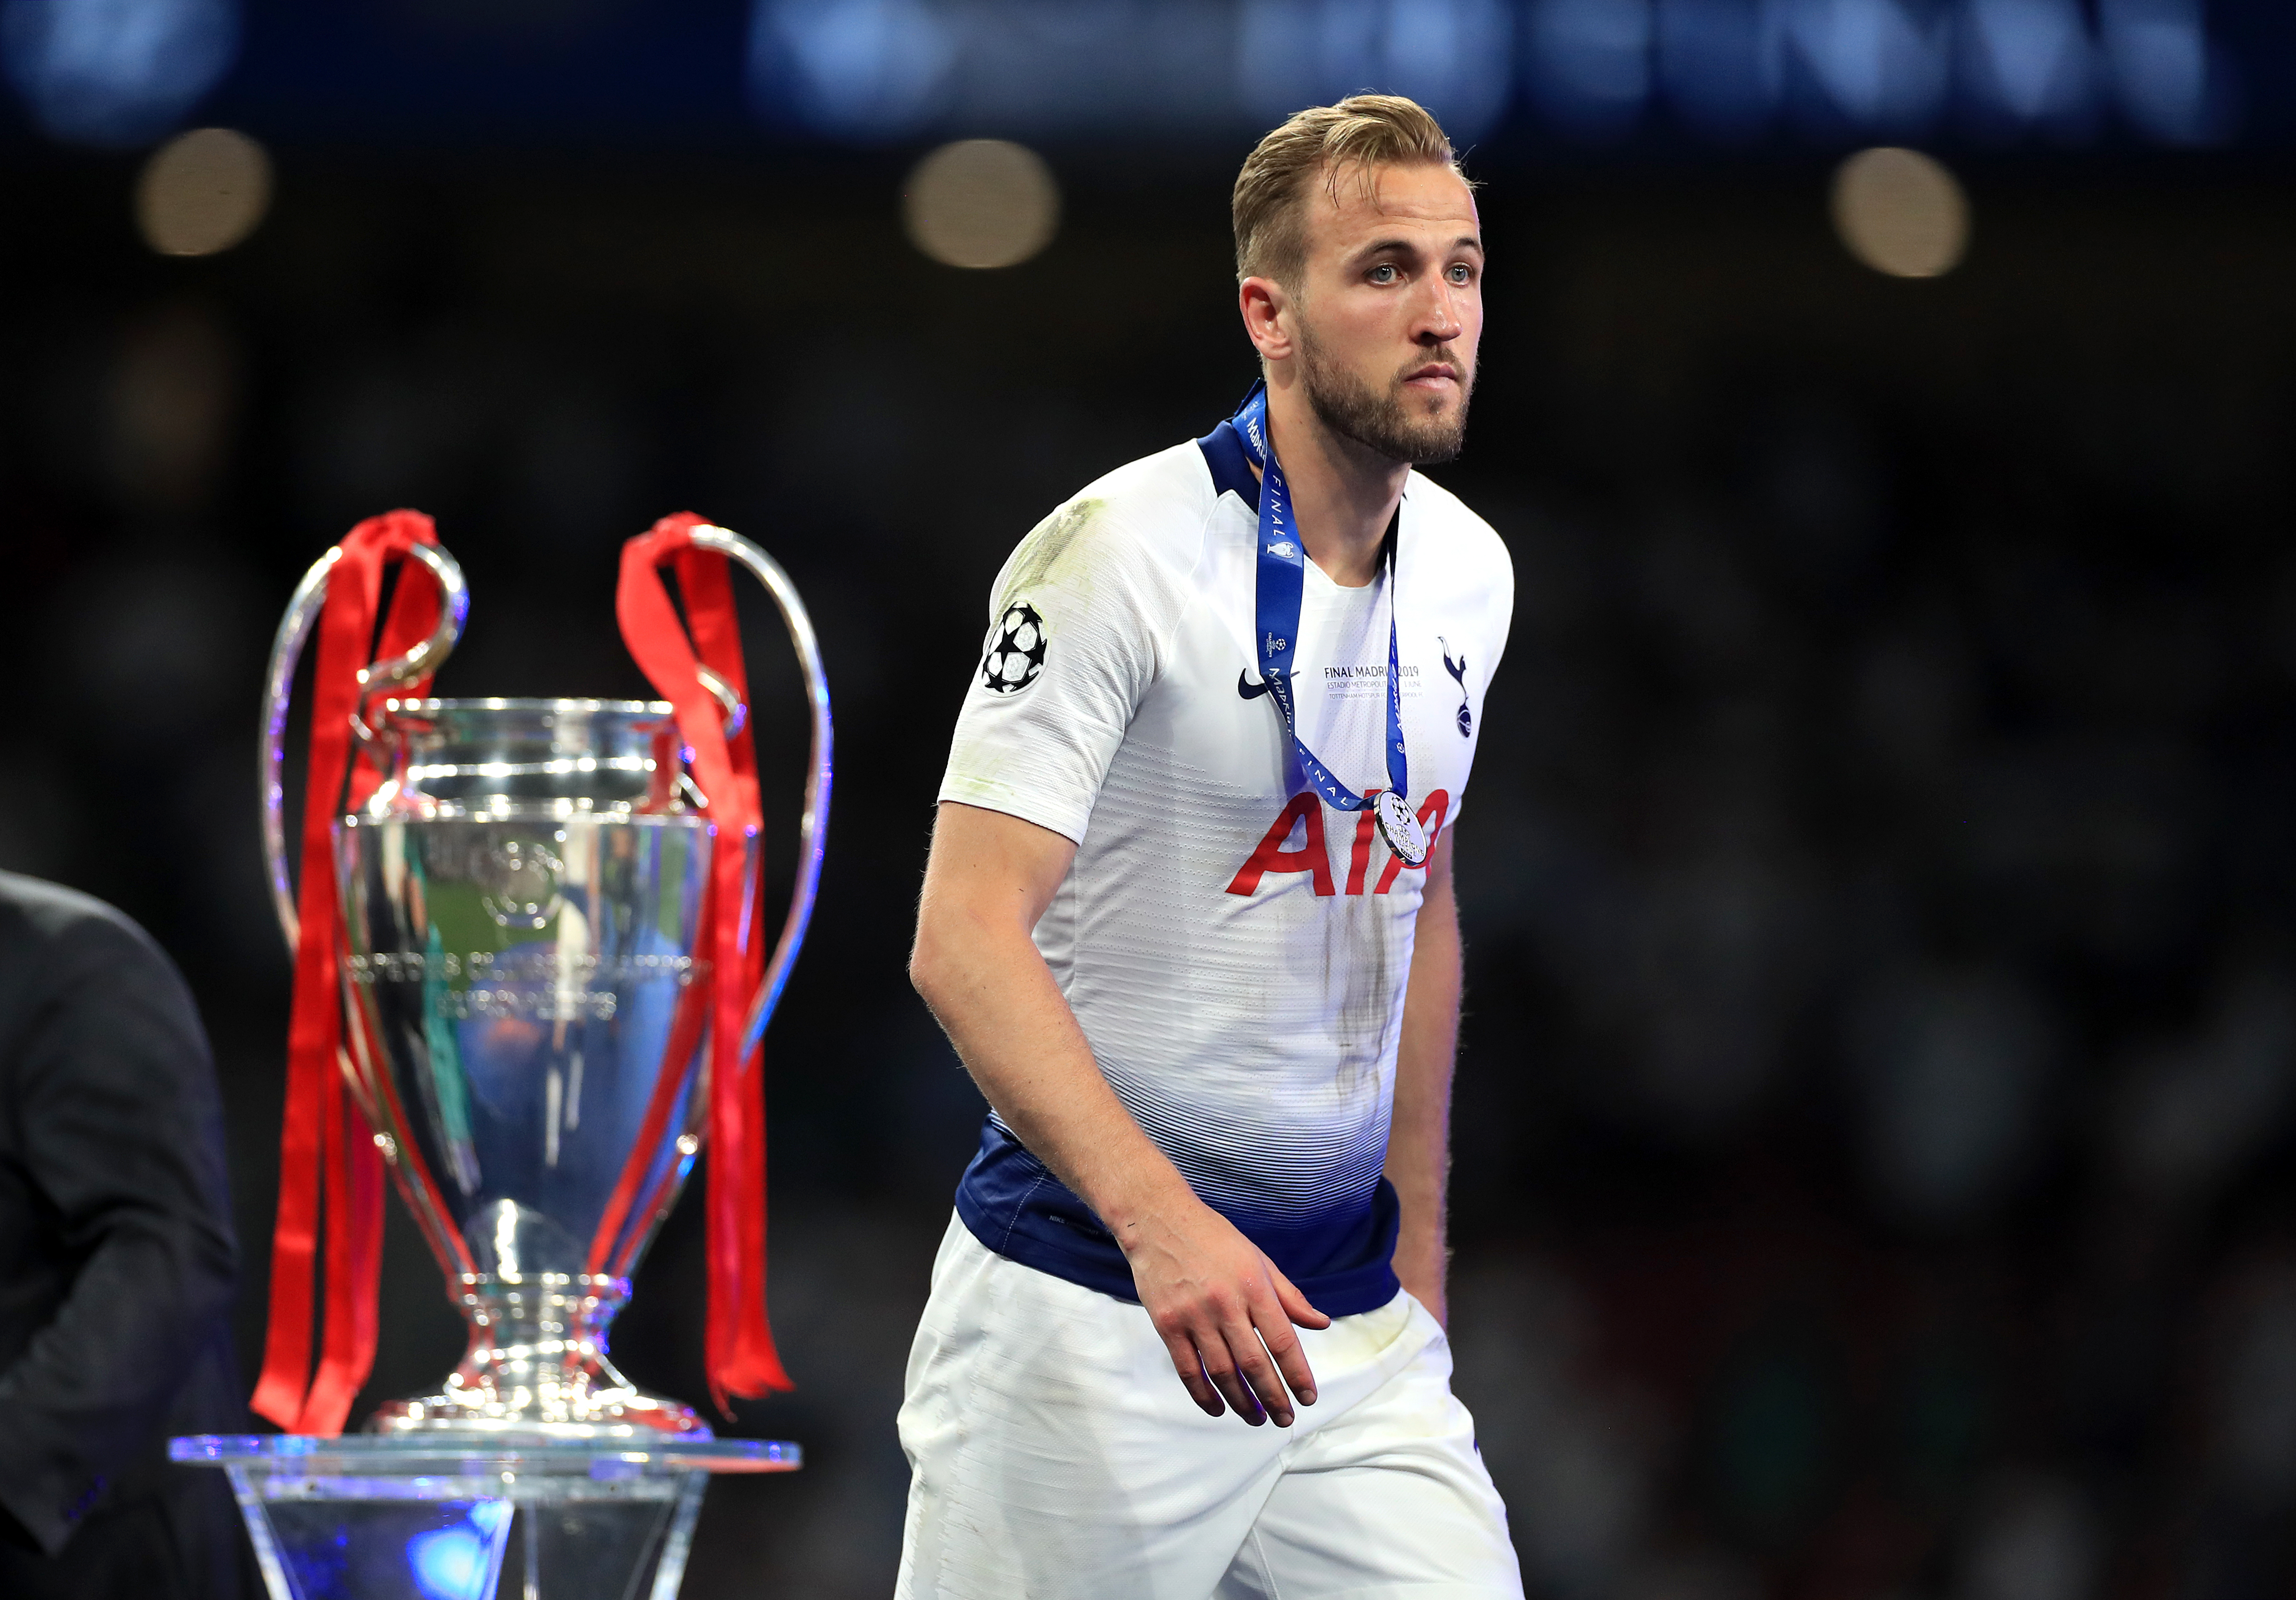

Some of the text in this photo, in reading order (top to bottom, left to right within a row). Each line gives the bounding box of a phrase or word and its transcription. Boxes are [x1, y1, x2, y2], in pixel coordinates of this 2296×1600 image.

[1271, 474, 1285, 536] FINAL
[1324, 666, 1354, 679] FINAL
[1355, 666, 1388, 677] MADRI
[1398, 666, 1419, 677] 2019
[1327, 681, 1351, 689] ESTADIO
[1299, 748, 1348, 806] FINAL
[1225, 789, 1449, 896] AIA
[1384, 822, 1424, 856] CHAMPIONS
[1049, 1215, 1065, 1224] NIKE
